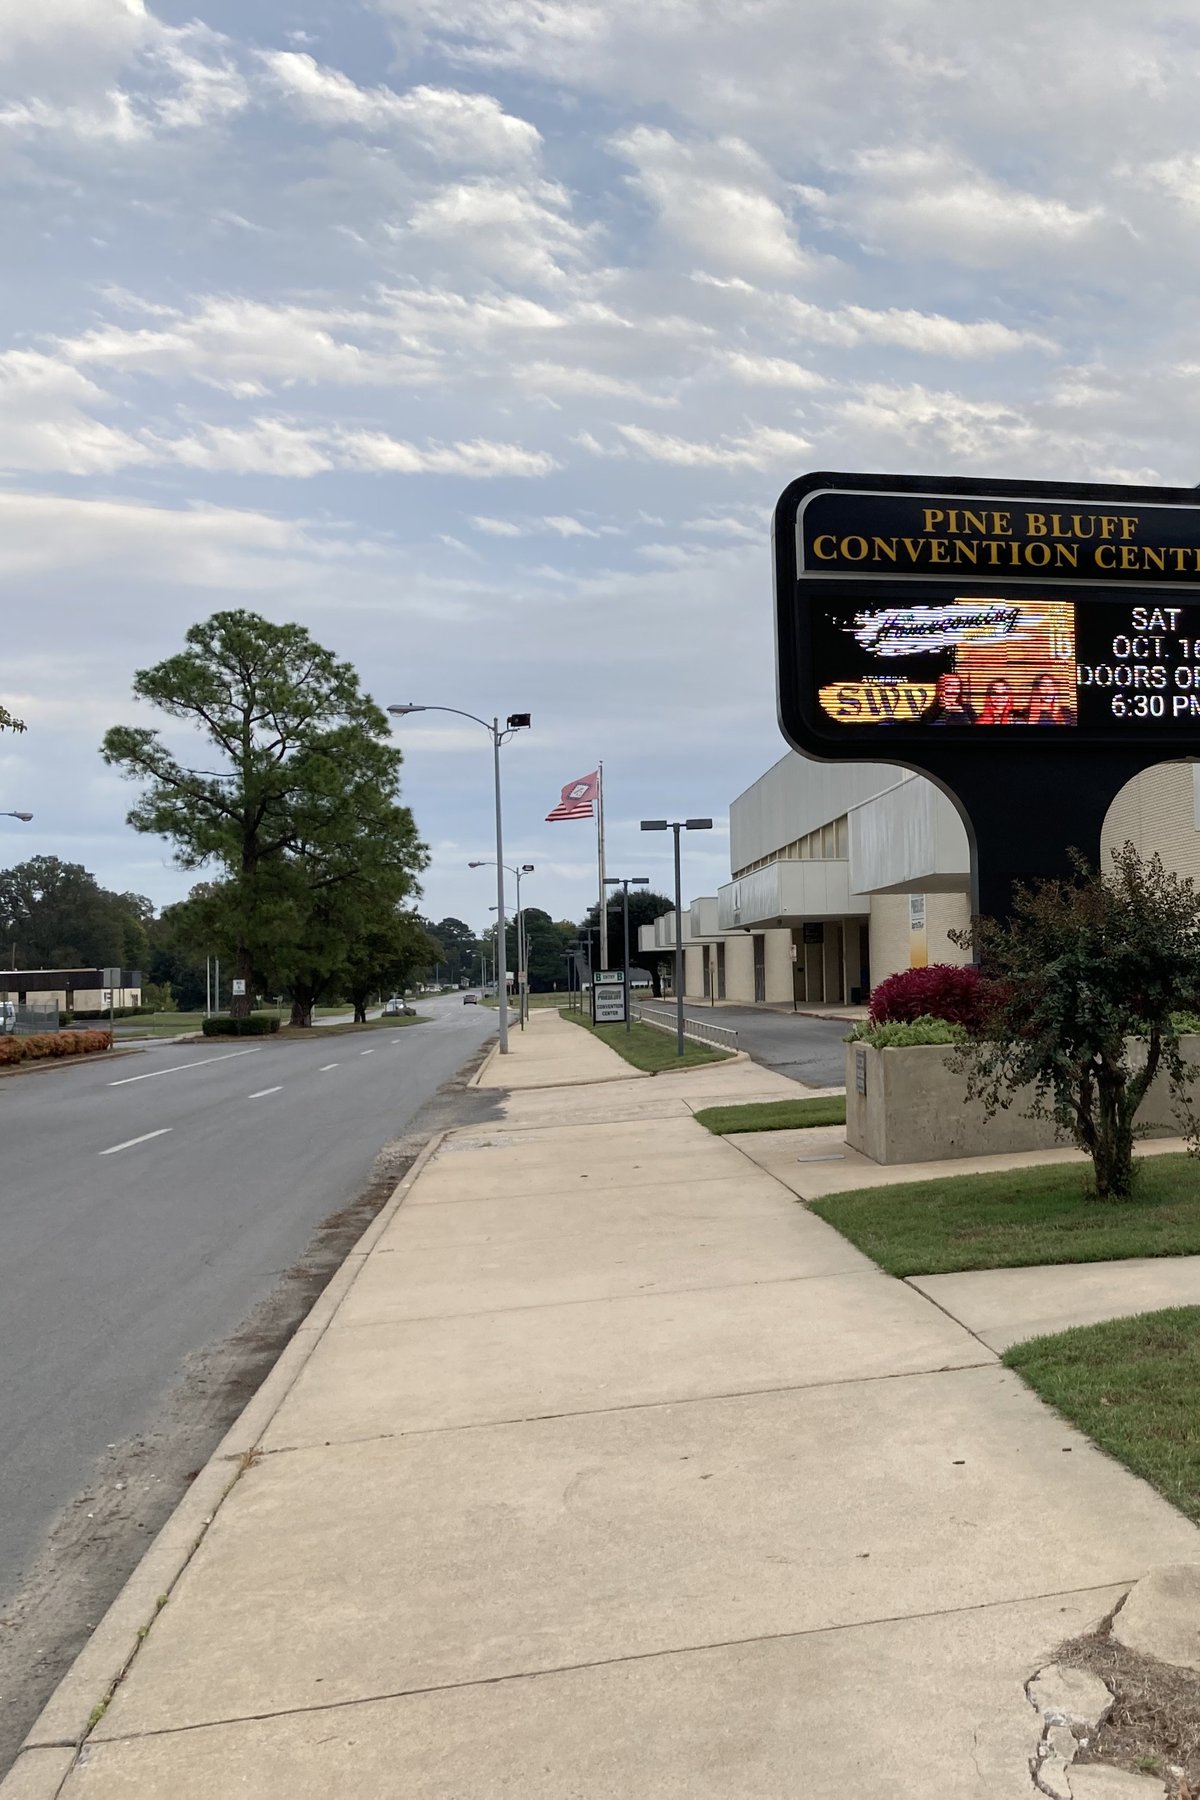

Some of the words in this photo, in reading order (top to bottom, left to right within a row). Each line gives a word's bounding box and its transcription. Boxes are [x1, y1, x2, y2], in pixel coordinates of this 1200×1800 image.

[922, 508, 1013, 536] PINE
[1025, 513, 1139, 540] BLUFF
[813, 534, 1079, 568] CONVENTION
[1132, 607, 1182, 631] SAT
[1112, 635, 1169, 659] OCT.
[1076, 664, 1167, 688] DOORS
[1111, 694, 1164, 717] 6:30
[596, 973, 601, 981] B
[617, 972, 622, 981] B
